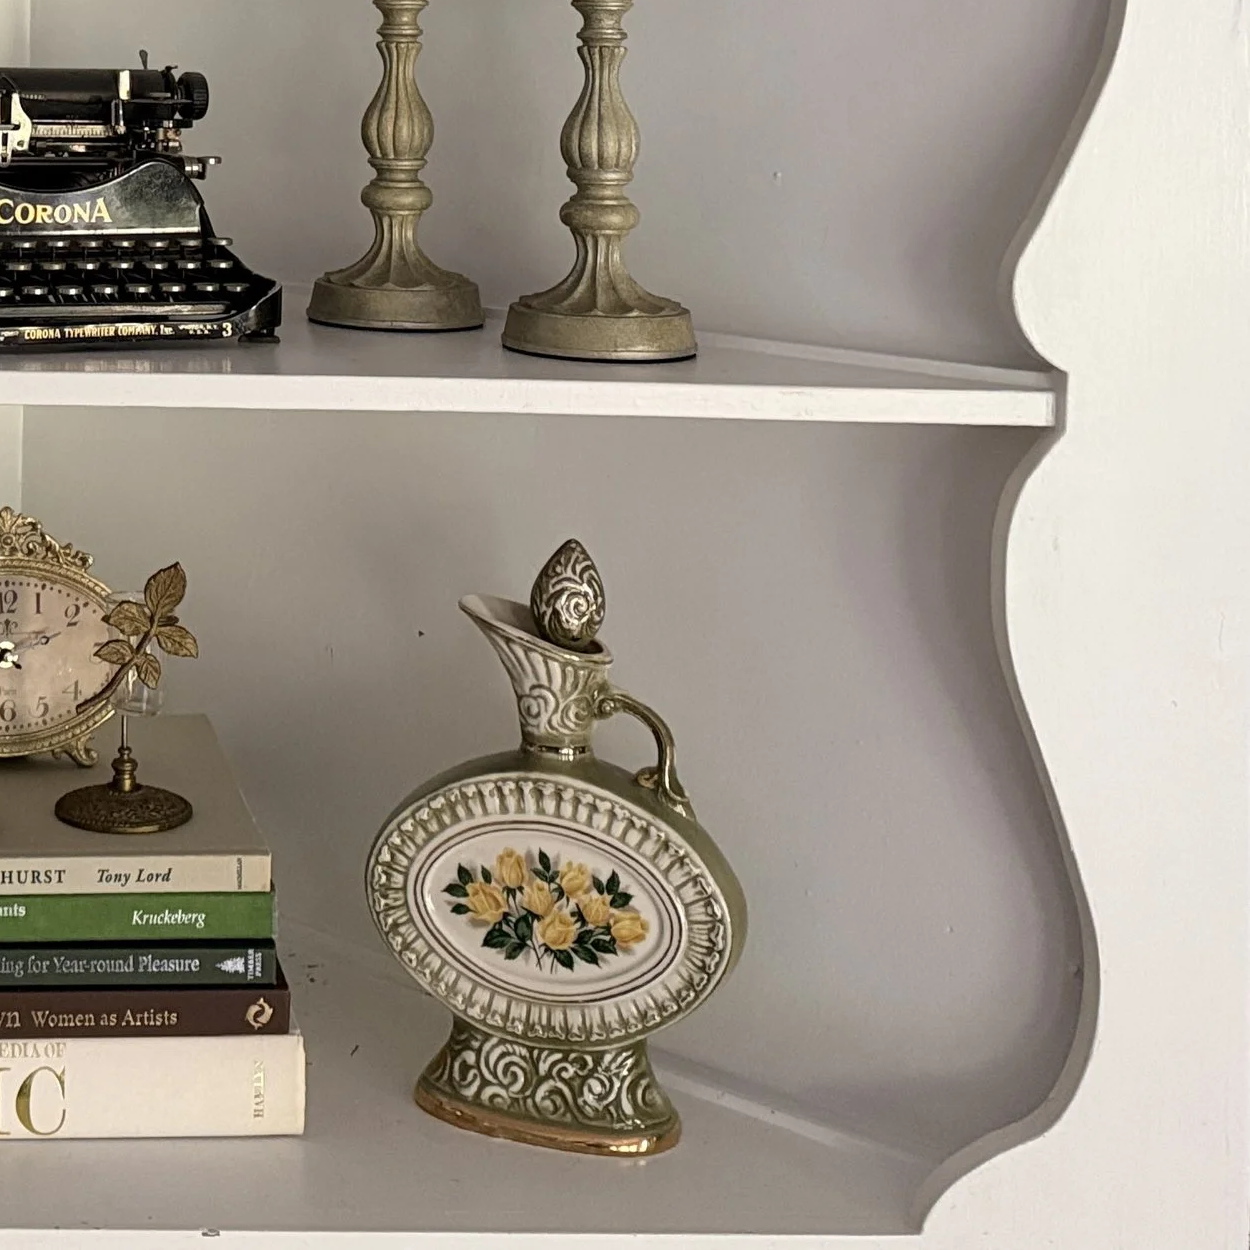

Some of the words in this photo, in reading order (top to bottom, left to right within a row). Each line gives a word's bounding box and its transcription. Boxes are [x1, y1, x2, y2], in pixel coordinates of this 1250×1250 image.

[24, 328, 61, 340] CORONA
[64, 326, 115, 338] TYPEWRITER
[222, 322, 233, 338] 3
[35, 592, 42, 614] 1
[65, 604, 80, 628] 2
[62, 680, 83, 701] 4
[0, 700, 17, 723] 6
[28, 696, 49, 719] 5
[97, 868, 131, 888] Tony
[136, 867, 173, 884] Lord
[132, 909, 206, 929] Kruckeberg
[28, 954, 50, 974] for
[53, 954, 134, 973] Year-round
[138, 953, 200, 973] Pleasure
[31, 1009, 95, 1028] Women
[100, 1011, 117, 1026] as
[122, 1007, 178, 1026] Artists
[44, 1042, 67, 1058] OF
